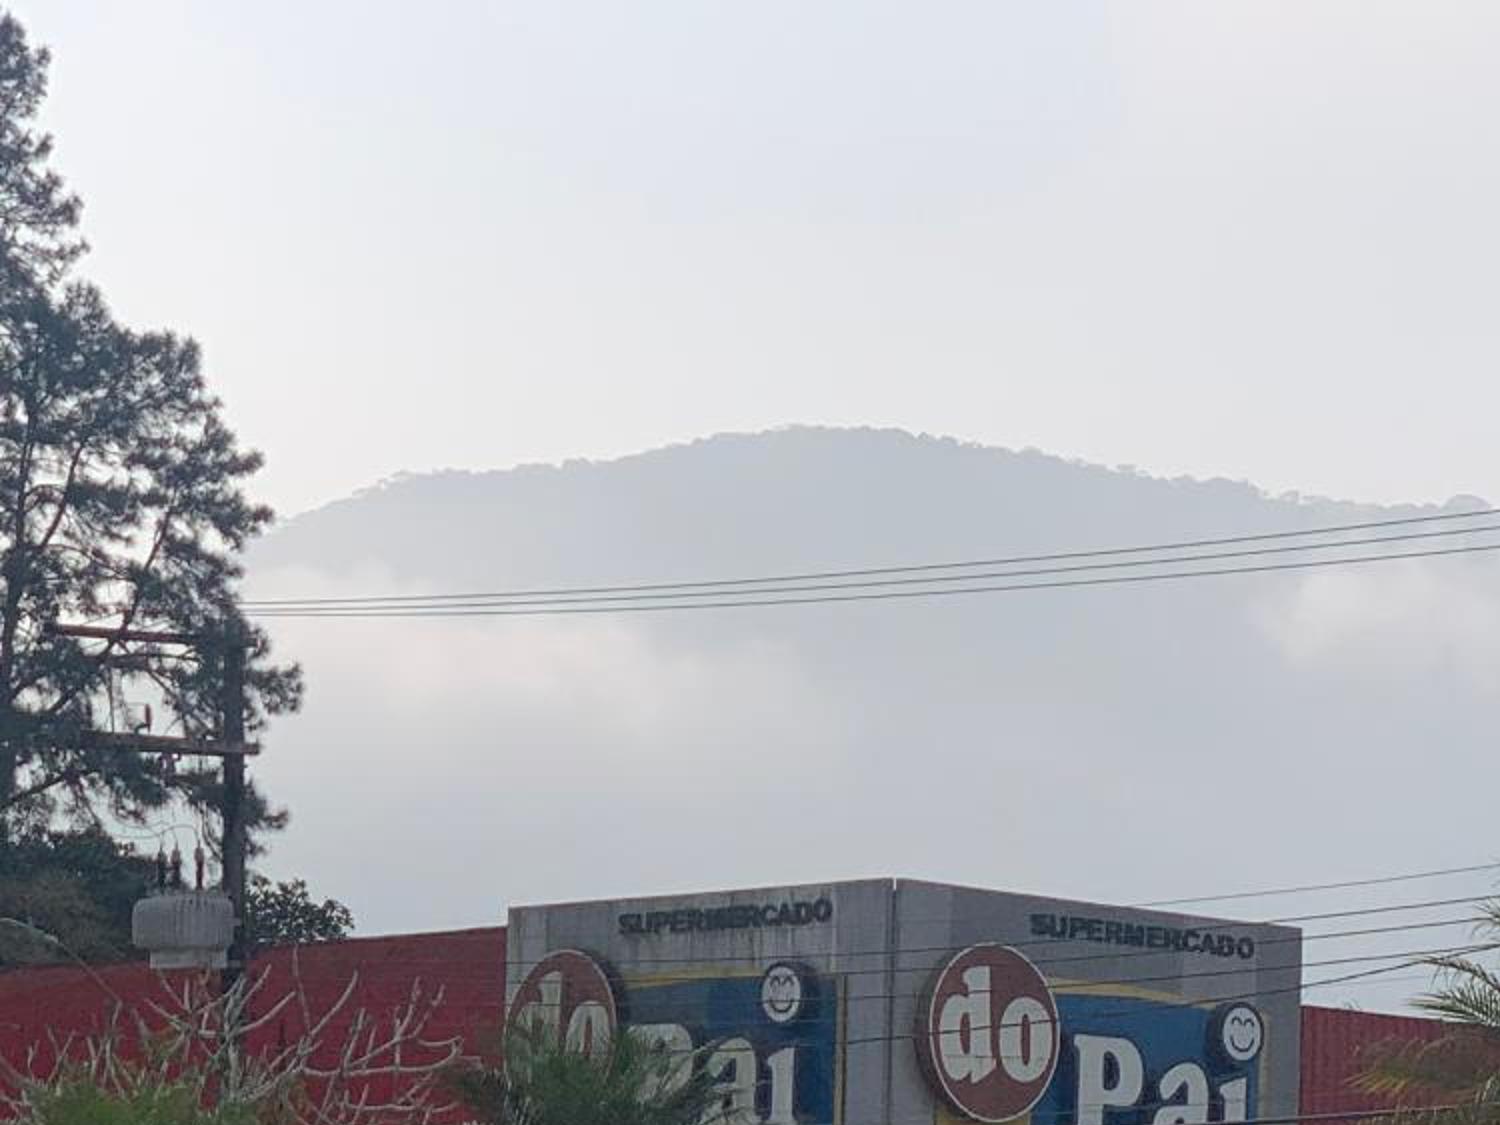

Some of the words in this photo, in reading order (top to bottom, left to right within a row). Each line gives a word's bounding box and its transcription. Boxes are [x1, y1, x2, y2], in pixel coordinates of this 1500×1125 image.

[618, 896, 833, 935] SUPERMERCADO
[1030, 913, 1255, 960] SUPERMERCADO
[939, 965, 1053, 1083] do
